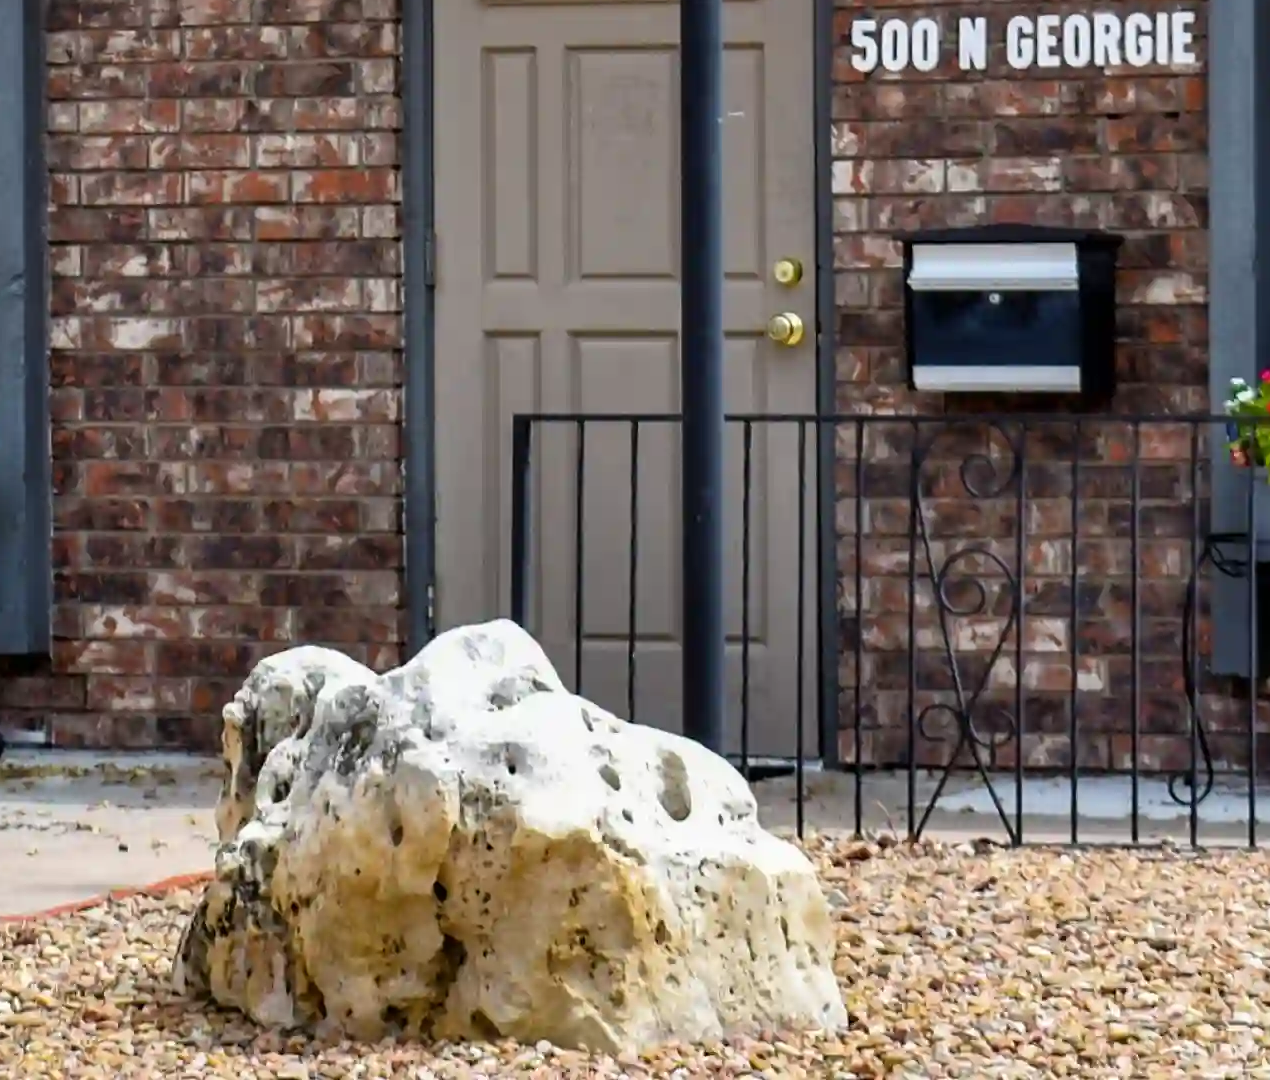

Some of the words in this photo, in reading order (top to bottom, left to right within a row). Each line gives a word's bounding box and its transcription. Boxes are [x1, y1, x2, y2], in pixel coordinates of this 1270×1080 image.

[851, 18, 940, 72] 500
[958, 17, 987, 70] N
[1006, 11, 1196, 70] GEORGIE
